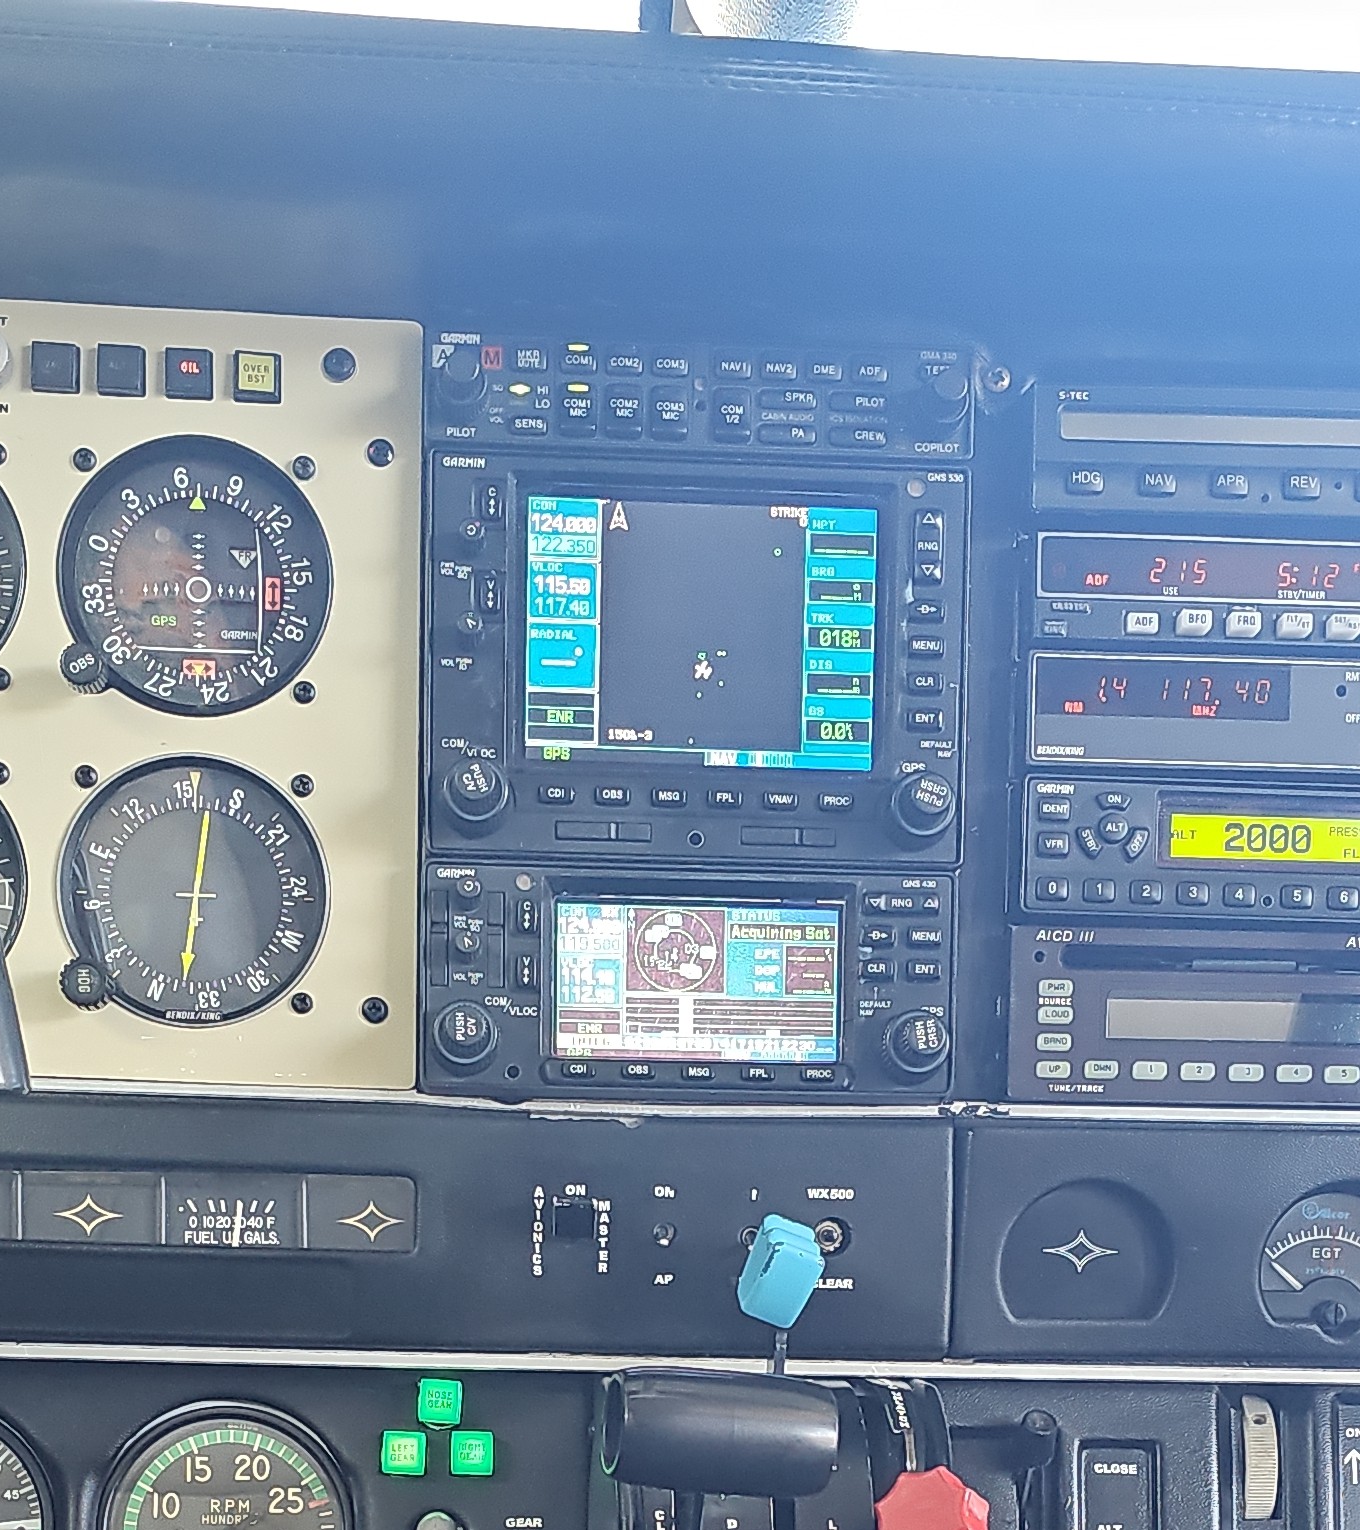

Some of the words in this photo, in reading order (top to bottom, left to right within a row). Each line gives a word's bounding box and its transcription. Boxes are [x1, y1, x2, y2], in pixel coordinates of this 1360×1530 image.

[179, 360, 200, 374] OIL
[656, 358, 685, 370] COM3
[766, 363, 792, 374] NAV2
[785, 392, 813, 404] SPKR
[915, 441, 959, 454] COPILOT
[442, 456, 486, 468] GARMIN
[1072, 471, 1101, 485] HDG
[1145, 474, 1173, 486] NAV
[1217, 475, 1244, 487] APR
[532, 536, 595, 554] 122.350
[535, 597, 589, 616] 117.40
[152, 616, 176, 626] GPS
[221, 630, 257, 640] GARMIN
[912, 640, 939, 651] MENU
[69, 654, 95, 674] OBS
[916, 677, 934, 687] CLR
[547, 710, 574, 723] ENR
[916, 714, 935, 724] ENT
[716, 792, 734, 803] FPL
[769, 794, 793, 804] VNAV
[1223, 822, 1311, 854] 2000
[1344, 848, 1360, 859] FL
[731, 927, 801, 940] Acquiring
[806, 928, 830, 940] Sat
[912, 932, 940, 942] MENU
[1037, 931, 1073, 942] AICD
[1078, 931, 1094, 942] III
[78, 969, 90, 992] HDG
[166, 1010, 220, 1020] BENDIX/KING
[565, 1185, 586, 1196] ON
[808, 1188, 854, 1200] WX500
[533, 1186, 544, 1276] AVIONICS
[598, 1201, 611, 1273] MASTER
[186, 1457, 211, 1482] 15
[235, 1455, 269, 1480] 20
[1094, 1464, 1137, 1474] CLOSE
[153, 1493, 180, 1518] 10
[269, 1488, 303, 1513] 25
[506, 1518, 542, 1527] GEAR
